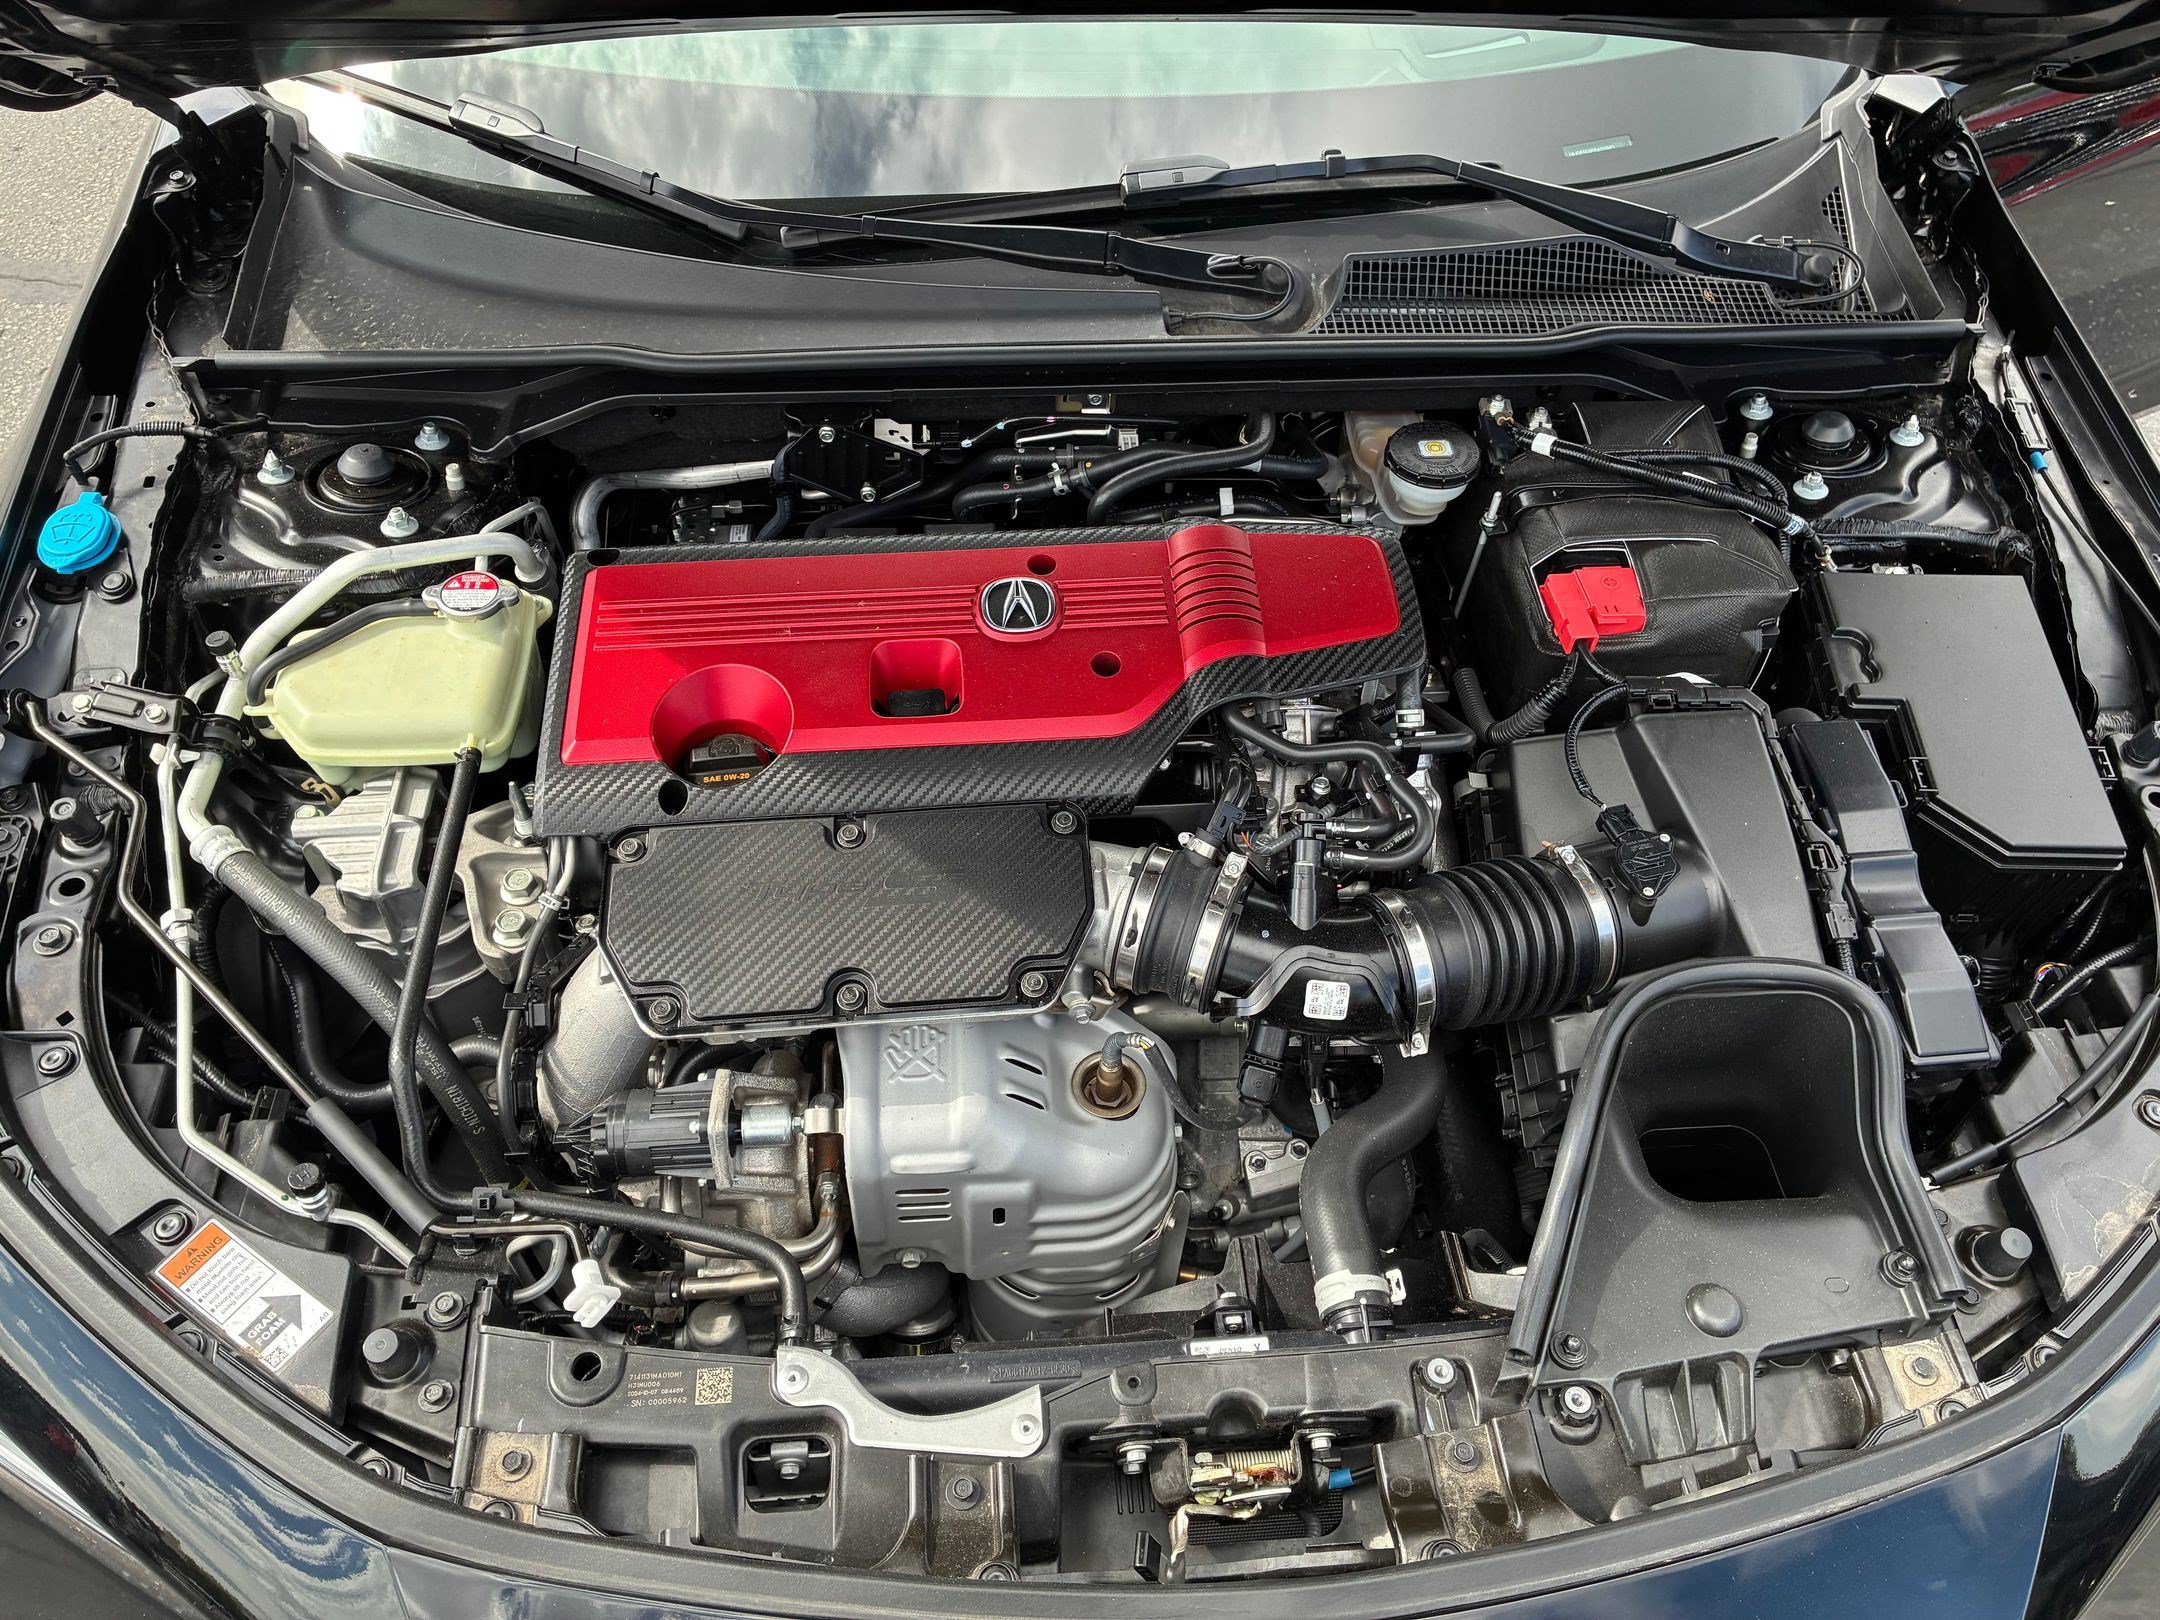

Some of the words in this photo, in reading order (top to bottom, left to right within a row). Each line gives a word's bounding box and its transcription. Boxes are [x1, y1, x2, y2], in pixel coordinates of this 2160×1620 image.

[703, 775, 722, 783] SAE
[723, 772, 750, 781] 0W-20
[174, 1236, 223, 1280] WARNING
[247, 1310, 278, 1340] GRAB
[255, 1316, 287, 1347] FOAM
[648, 1396, 688, 1406] 00005962
